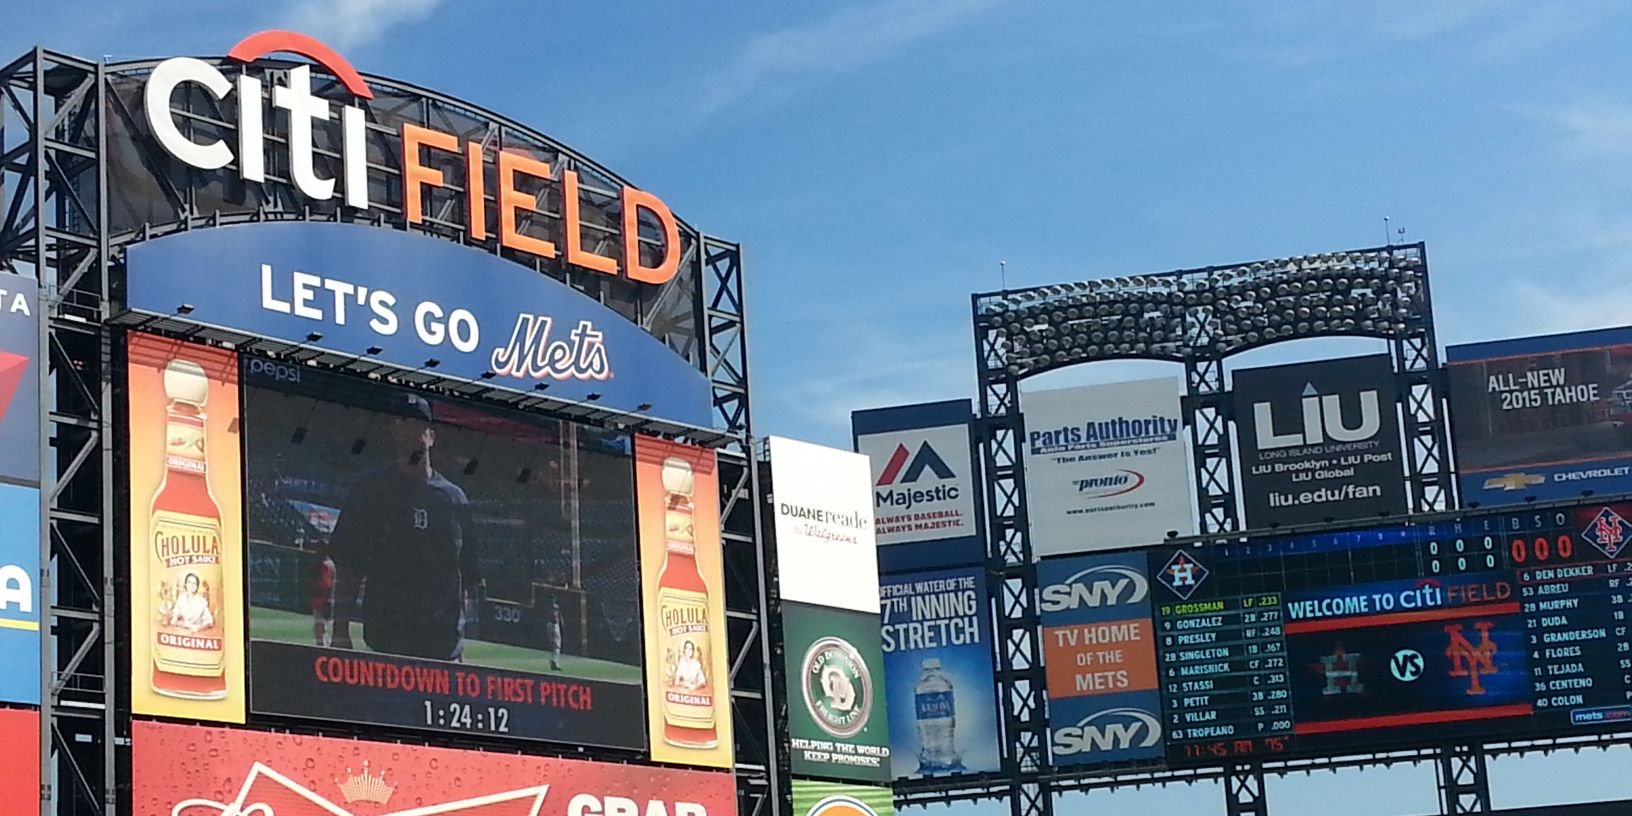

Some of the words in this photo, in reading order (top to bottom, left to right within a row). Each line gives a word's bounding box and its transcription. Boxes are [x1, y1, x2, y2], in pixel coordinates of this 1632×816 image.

[145, 57, 369, 209] citi
[400, 123, 680, 285] FIELD
[261, 264, 398, 336] LET'S
[414, 302, 480, 353] GO
[491, 313, 613, 380] Mets
[1488, 368, 1565, 392] ALL-NEW
[1502, 390, 1541, 410] 2015
[1544, 384, 1600, 406] TAHOE
[1030, 426, 1081, 448] Parts
[1086, 415, 1178, 442] Authority
[1078, 451, 1118, 462] Answer
[1121, 450, 1131, 458] Is
[1259, 451, 1287, 461] LONG
[1289, 447, 1323, 458] ISLAND
[1325, 440, 1380, 453] UNIVERSITY
[1252, 464, 1271, 475] LIU
[1274, 459, 1329, 474] Brooklyn
[1341, 454, 1360, 465] LIU
[1364, 452, 1393, 463] Post
[1292, 472, 1312, 482] LIU
[1315, 468, 1354, 479] Global
[1554, 466, 1630, 482] CHEVROLET
[1079, 474, 1128, 491] pronto
[876, 485, 959, 510] Majestic
[1269, 484, 1381, 507] liu.edu/fan
[875, 514, 912, 525] ALWAYS
[1512, 518, 1519, 529] B
[1534, 515, 1541, 527] S
[876, 524, 913, 535] ALWAYS
[154, 531, 220, 562] CHOLULA
[1536, 569, 1554, 580] DEN
[1557, 565, 1594, 578] DEKKER
[914, 580, 945, 594] WATER
[946, 578, 957, 590] OF
[957, 576, 976, 589] THE
[1538, 583, 1569, 595] ABREU
[1041, 578, 1130, 612] SNY
[1288, 595, 1368, 619] WELCOME
[1373, 593, 1394, 611] TO
[1400, 585, 1442, 608] citi
[1447, 581, 1511, 603] FIELD
[880, 597, 908, 624] 7TH
[911, 590, 977, 621] INNING
[1175, 601, 1224, 614] GROSSMAN
[1539, 598, 1579, 611] MURPHY
[661, 605, 708, 631] CHOLULA
[1176, 616, 1222, 630] GONZALEZ
[1541, 615, 1568, 627] DUDA
[160, 634, 219, 649] ORIGINAL
[881, 616, 979, 652] STRETCH
[1054, 629, 1078, 647] TV
[1084, 623, 1141, 646] HOME
[1178, 632, 1216, 645] PRESLEY
[1543, 628, 1606, 643] GRANDERSON
[1077, 652, 1094, 666] OF
[1096, 650, 1123, 664] THE
[1179, 648, 1229, 661] SINGLETON
[1545, 646, 1582, 659] FLORES
[1180, 663, 1230, 676] MARISNICK
[1393, 654, 1421, 678] VS
[1547, 662, 1584, 675] TEJADA
[315, 656, 449, 695] COUNTDOWN
[456, 671, 480, 698] TO
[487, 676, 533, 704] FIRST
[539, 682, 593, 710] PITCH
[1075, 670, 1128, 692] METS
[1182, 680, 1214, 692] STASSI
[1549, 677, 1593, 690] CENTENO
[667, 693, 710, 706] ORIGINAL
[1184, 696, 1209, 707] PETIT
[1551, 694, 1584, 707] COLON
[424, 700, 509, 732] 1:24:12
[1185, 710, 1217, 722] VILLAR
[1052, 721, 1144, 756] SNY
[1187, 725, 1234, 738] TROPEANO
[791, 738, 833, 751] HELPING
[835, 743, 855, 754] THE
[856, 744, 890, 757] WORLD
[804, 750, 830, 762] KEEP
